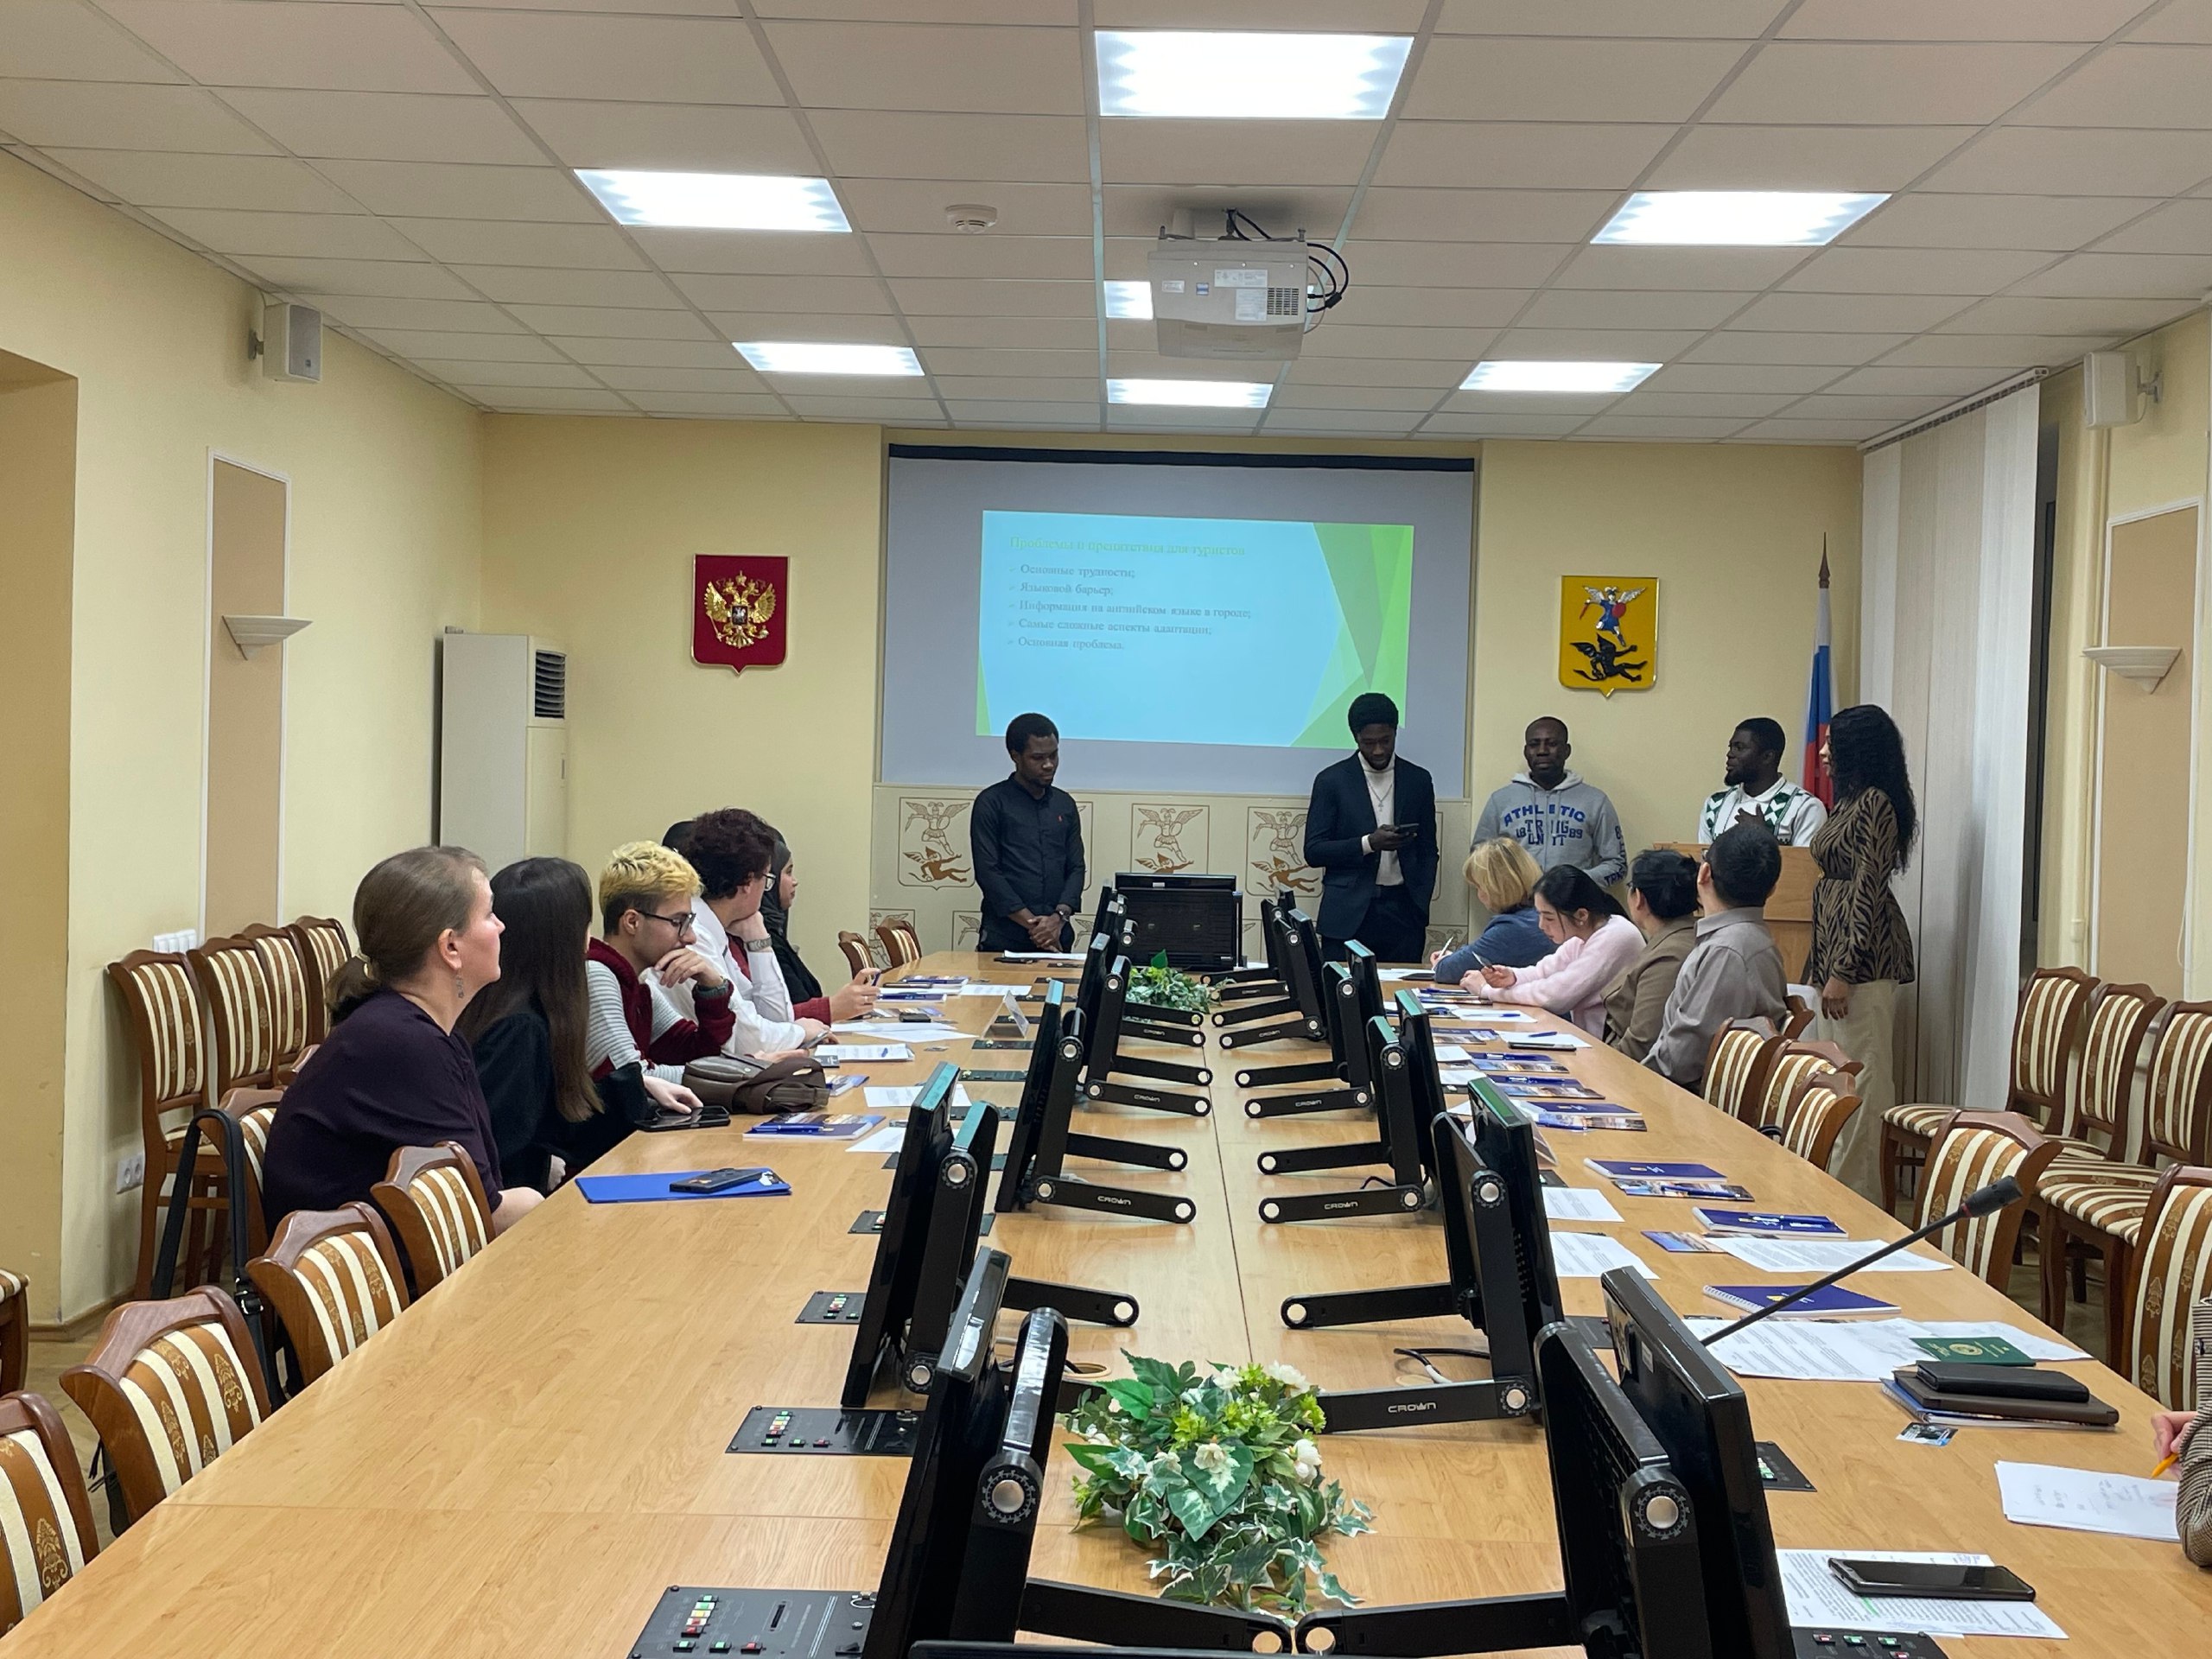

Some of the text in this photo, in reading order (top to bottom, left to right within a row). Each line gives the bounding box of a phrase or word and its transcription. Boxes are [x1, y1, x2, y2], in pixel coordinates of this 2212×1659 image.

[1010, 536, 1073, 550] Проблемы
[1167, 544, 1189, 554] для
[1192, 546, 1245, 557] туристов
[1020, 564, 1135, 578] Основные трудности;
[1020, 582, 1114, 596] Языковой барьер;
[1019, 600, 1088, 613] Информация
[1106, 605, 1166, 614] английском
[1171, 607, 1202, 616] языке
[1213, 609, 1251, 619] городе;
[1019, 618, 1211, 635] Самые сложные аспекты адаптации;
[1018, 637, 1125, 651] Основная проблема.
[1503, 804, 1586, 827] ATHLETIC
[1097, 1195, 1132, 1205] CROWN
[1324, 1200, 1358, 1210] CROWN
[1388, 1402, 1437, 1413] CROWN
